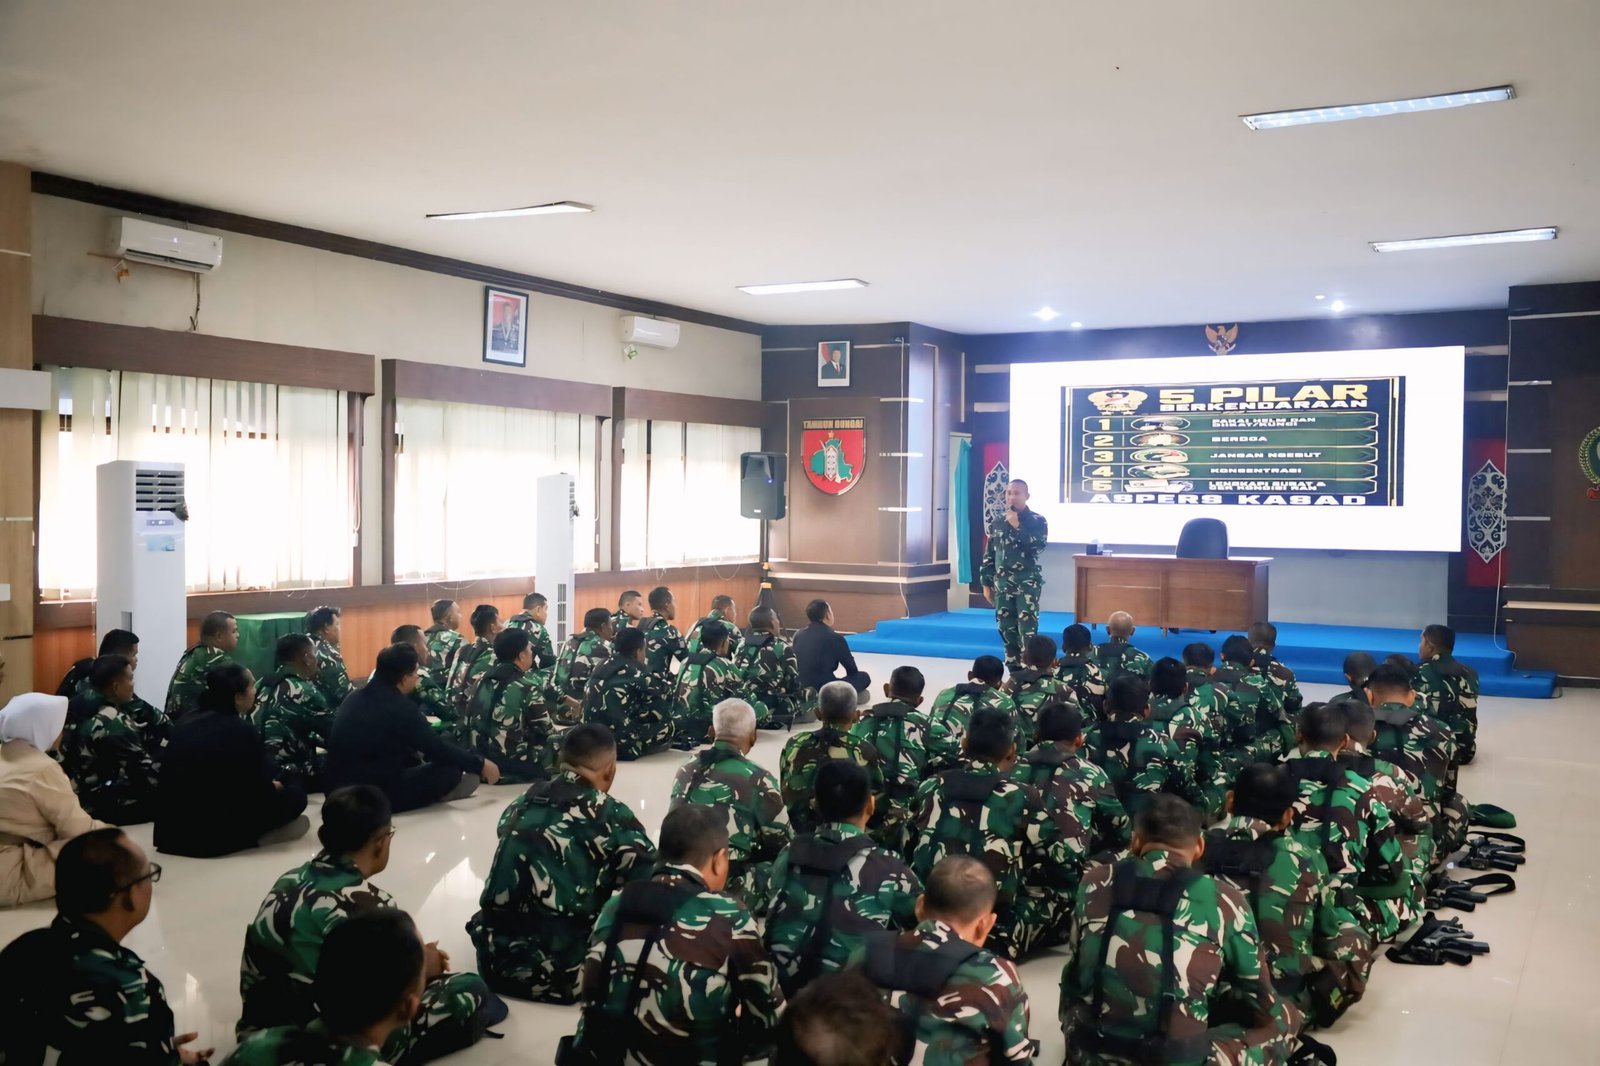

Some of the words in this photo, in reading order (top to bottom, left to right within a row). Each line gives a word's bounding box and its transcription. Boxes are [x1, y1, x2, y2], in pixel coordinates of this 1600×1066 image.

[1159, 388, 1195, 404] 5
[1210, 384, 1368, 404] PILAR
[1159, 399, 1368, 412] BERKENDARAAN
[1098, 419, 1110, 430] 1
[1094, 435, 1114, 447] 2
[1094, 451, 1114, 463] 3
[1092, 466, 1114, 477] 4
[1092, 480, 1112, 491] 5
[1089, 494, 1222, 505] ASPERS
[1238, 494, 1366, 506] KASAD
